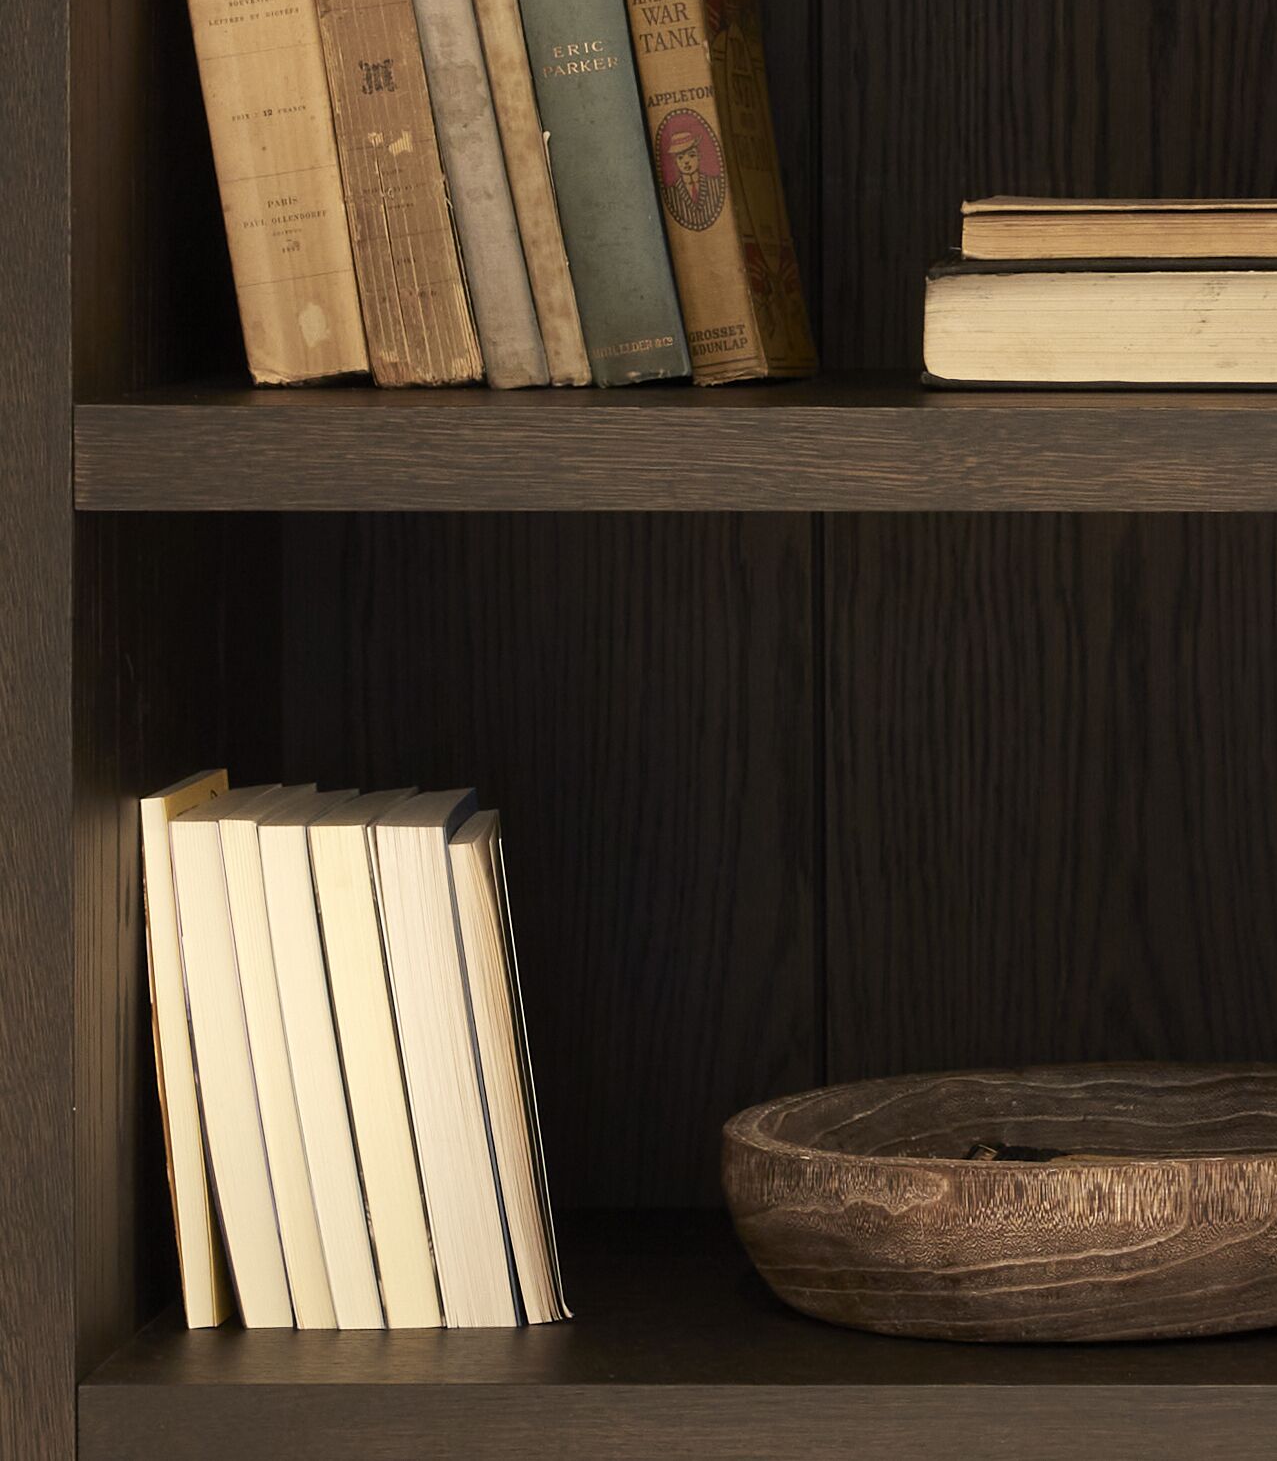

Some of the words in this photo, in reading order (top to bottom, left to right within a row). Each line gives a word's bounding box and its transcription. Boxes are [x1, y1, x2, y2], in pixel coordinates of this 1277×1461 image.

[642, 2, 690, 27] WAR
[554, 41, 604, 58] ERIC
[639, 26, 700, 54] TANK
[542, 56, 618, 78] PARKER
[647, 85, 713, 108] APPLETON
[263, 109, 273, 117] 12
[267, 196, 298, 208] PARIS
[689, 324, 745, 343] GROSSET
